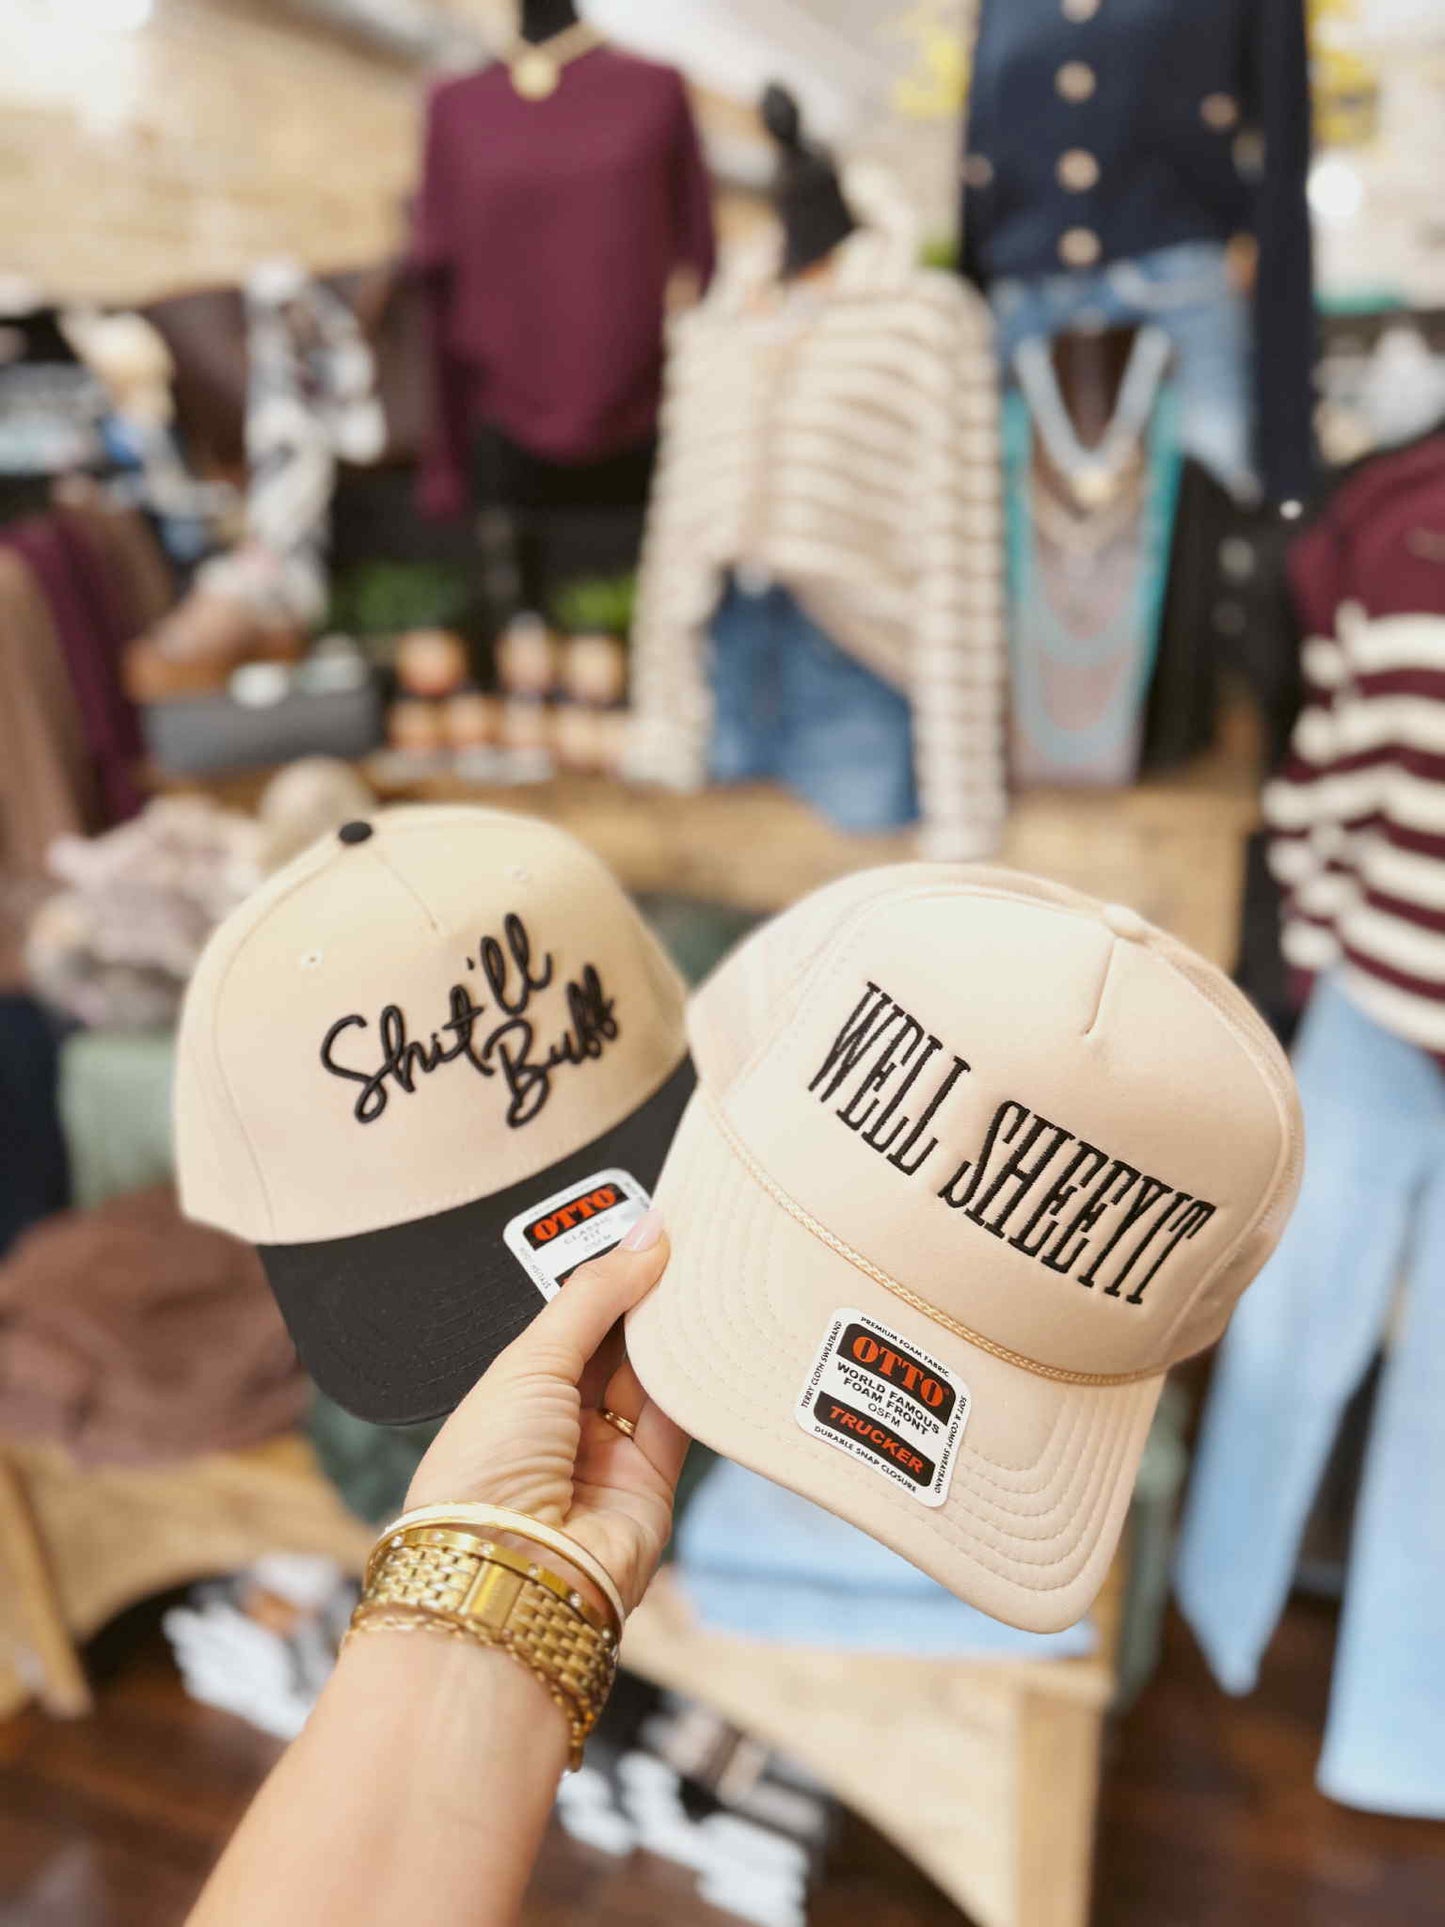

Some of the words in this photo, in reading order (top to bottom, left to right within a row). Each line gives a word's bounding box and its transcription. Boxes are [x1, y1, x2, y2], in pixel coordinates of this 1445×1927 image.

[807, 980, 972, 1177] WELL
[937, 1100, 1217, 1305] SHEEYIT
[533, 1188, 616, 1241] OTTO
[801, 1385, 816, 1408] TERRY
[812, 1362, 826, 1386] CLOTH
[820, 1320, 842, 1363] SWEATBAND
[852, 1336, 944, 1408] OTTO
[860, 1316, 898, 1340] PREMIUM
[899, 1339, 923, 1358] FOAM
[923, 1354, 950, 1378] FABRIC
[836, 1361, 886, 1394] WORLD
[889, 1392, 941, 1434] FAMOUS
[843, 1377, 883, 1404] FOAM
[886, 1400, 929, 1436] FRONT
[867, 1402, 901, 1428] OSFM
[814, 1425, 855, 1451] DURABLE
[855, 1447, 880, 1466] SNAP
[881, 1463, 917, 1494] CLOSURE
[829, 1405, 924, 1474] TRUCKER
